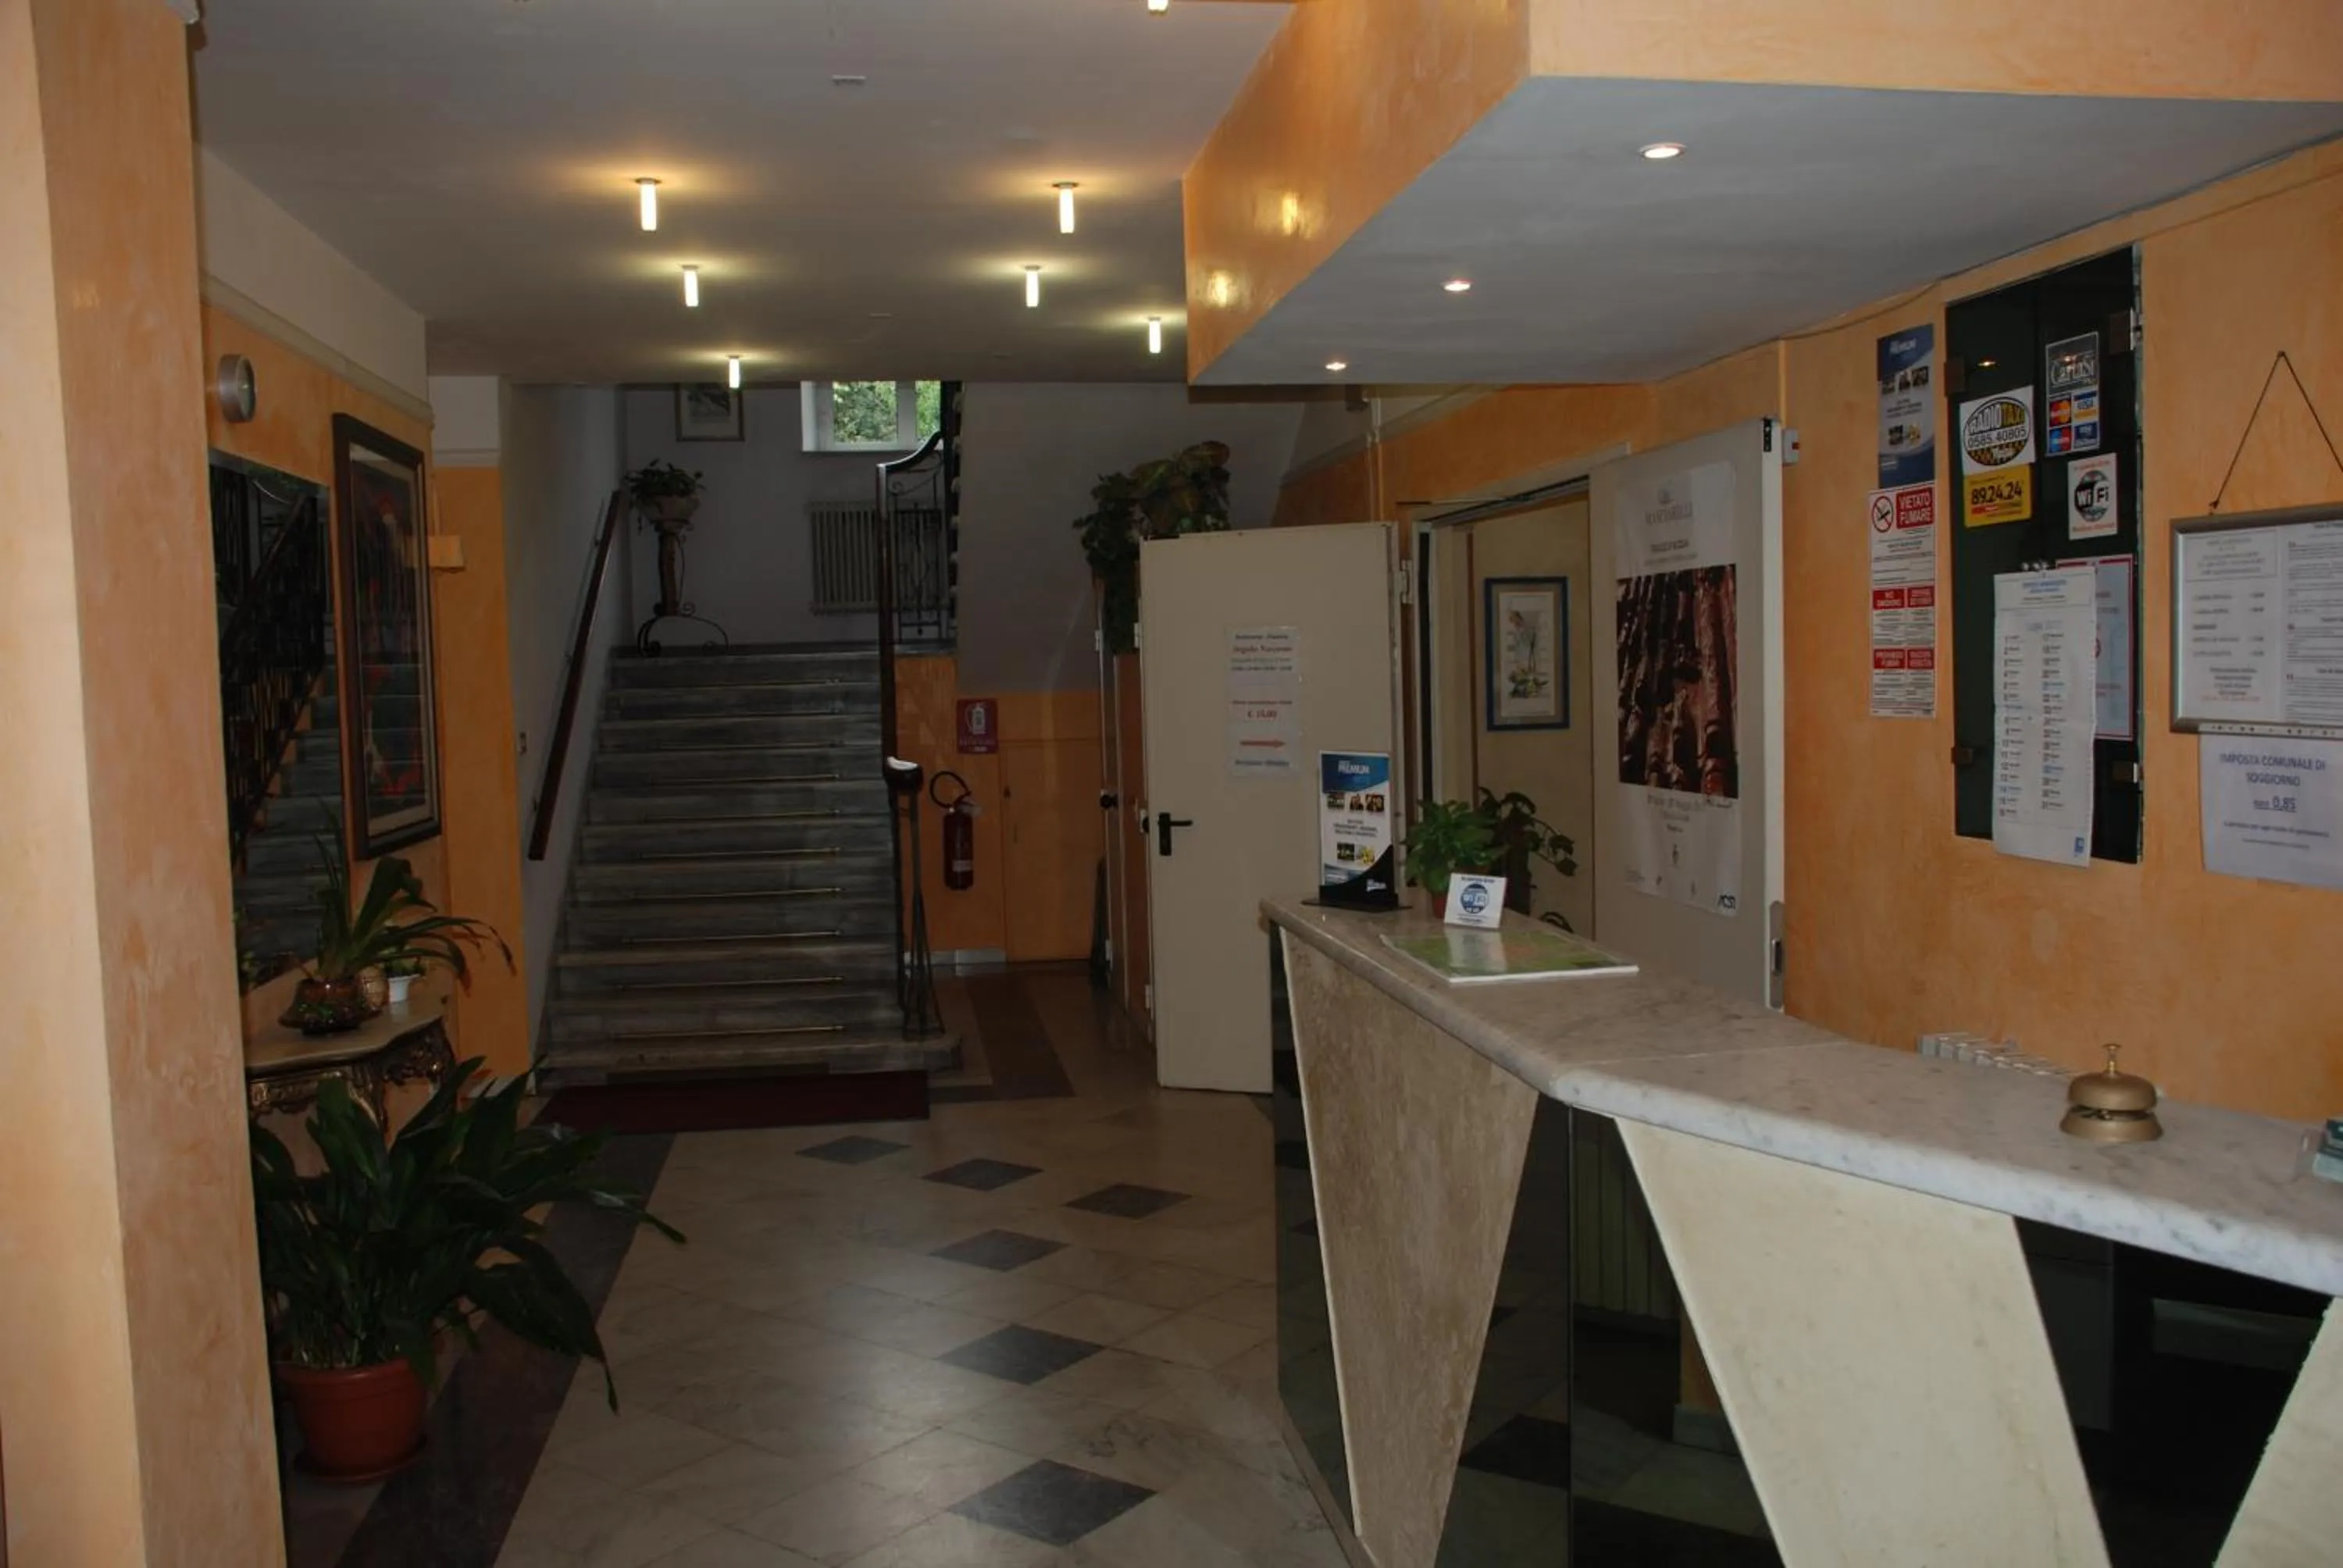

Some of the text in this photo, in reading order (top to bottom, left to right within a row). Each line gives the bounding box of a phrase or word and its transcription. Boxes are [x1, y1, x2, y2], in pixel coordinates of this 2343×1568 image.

[1899, 492, 1931, 509] VIETATO
[1899, 508, 1931, 525] FUMARE
[2220, 753, 2327, 771] IMPOSTA COMUNALE DI
[2246, 772, 2300, 786] SOGGIORNO
